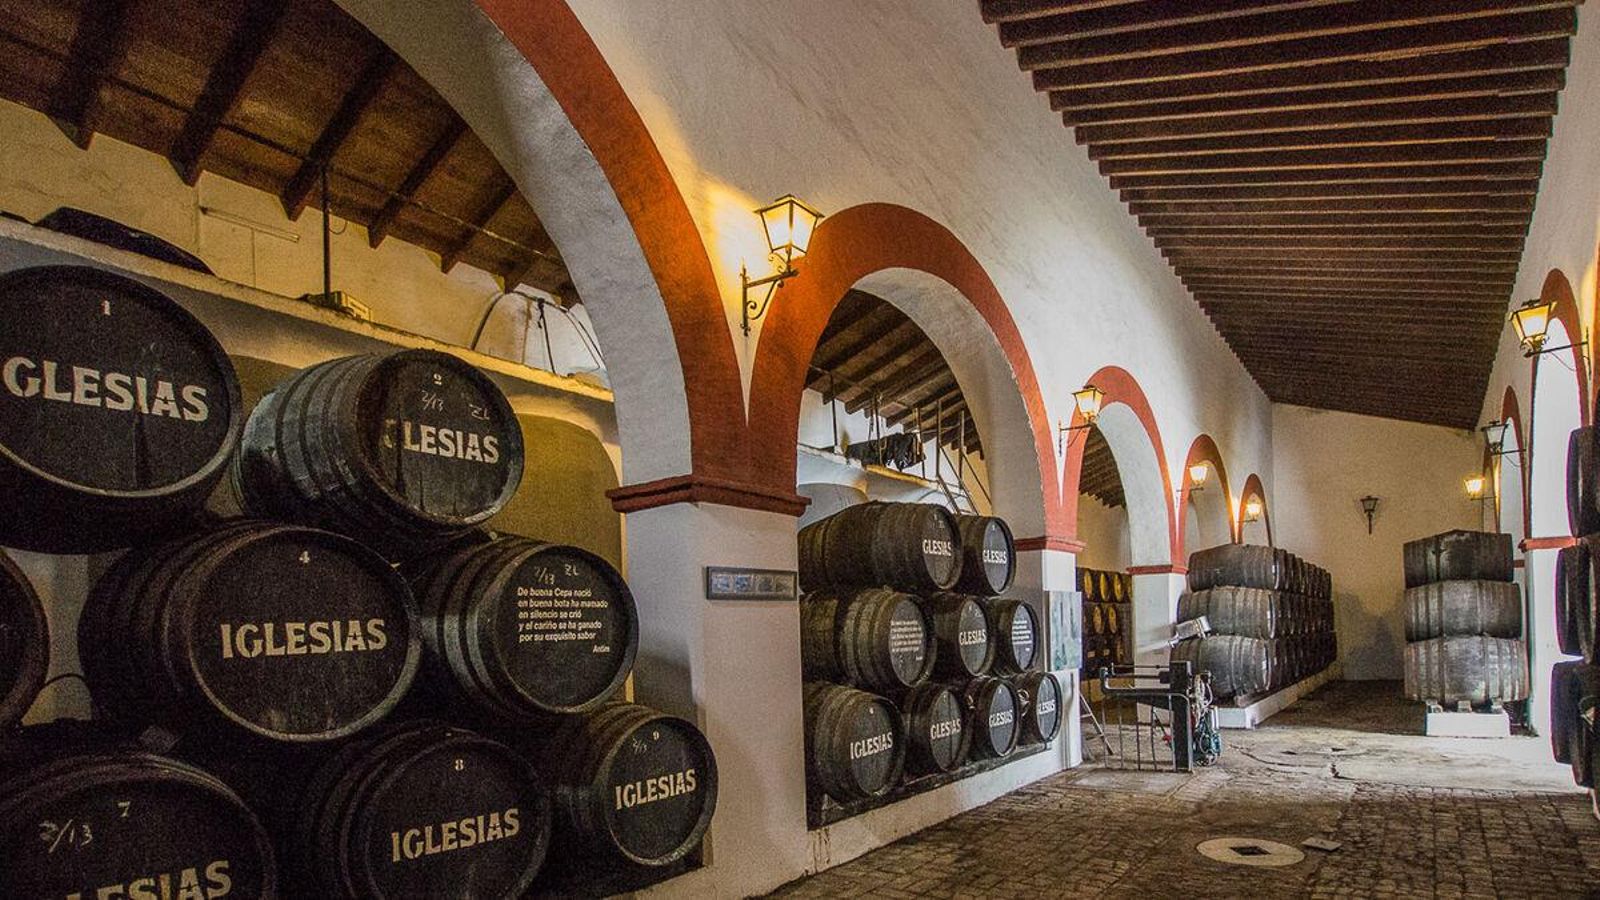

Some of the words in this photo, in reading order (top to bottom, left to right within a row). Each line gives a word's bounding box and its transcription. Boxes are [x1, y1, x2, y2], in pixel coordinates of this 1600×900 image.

[101, 300, 111, 316] 1
[299, 551, 310, 564] 4
[517, 587, 528, 597] De
[529, 588, 553, 597] buena
[554, 588, 573, 598] Cepa
[574, 588, 592, 597] nació
[529, 600, 553, 608] buena
[554, 600, 570, 608] bota
[570, 600, 580, 608] ha
[580, 600, 608, 609] mamado
[530, 611, 558, 619] silencio
[569, 610, 582, 618] crió
[518, 624, 524, 632] y
[526, 621, 533, 630] el
[534, 621, 557, 630] cariño
[568, 621, 577, 629] ha
[577, 621, 602, 631] ganado
[220, 618, 387, 659] IGLESIAS
[519, 634, 533, 643] por
[545, 632, 576, 642] exquisito
[577, 631, 596, 641] sabor
[850, 732, 893, 760] IGLESIAS
[455, 759, 464, 770] 8
[615, 769, 697, 810] IGLESIAS
[118, 801, 130, 817] 7
[391, 808, 520, 862] IGLESIAS
